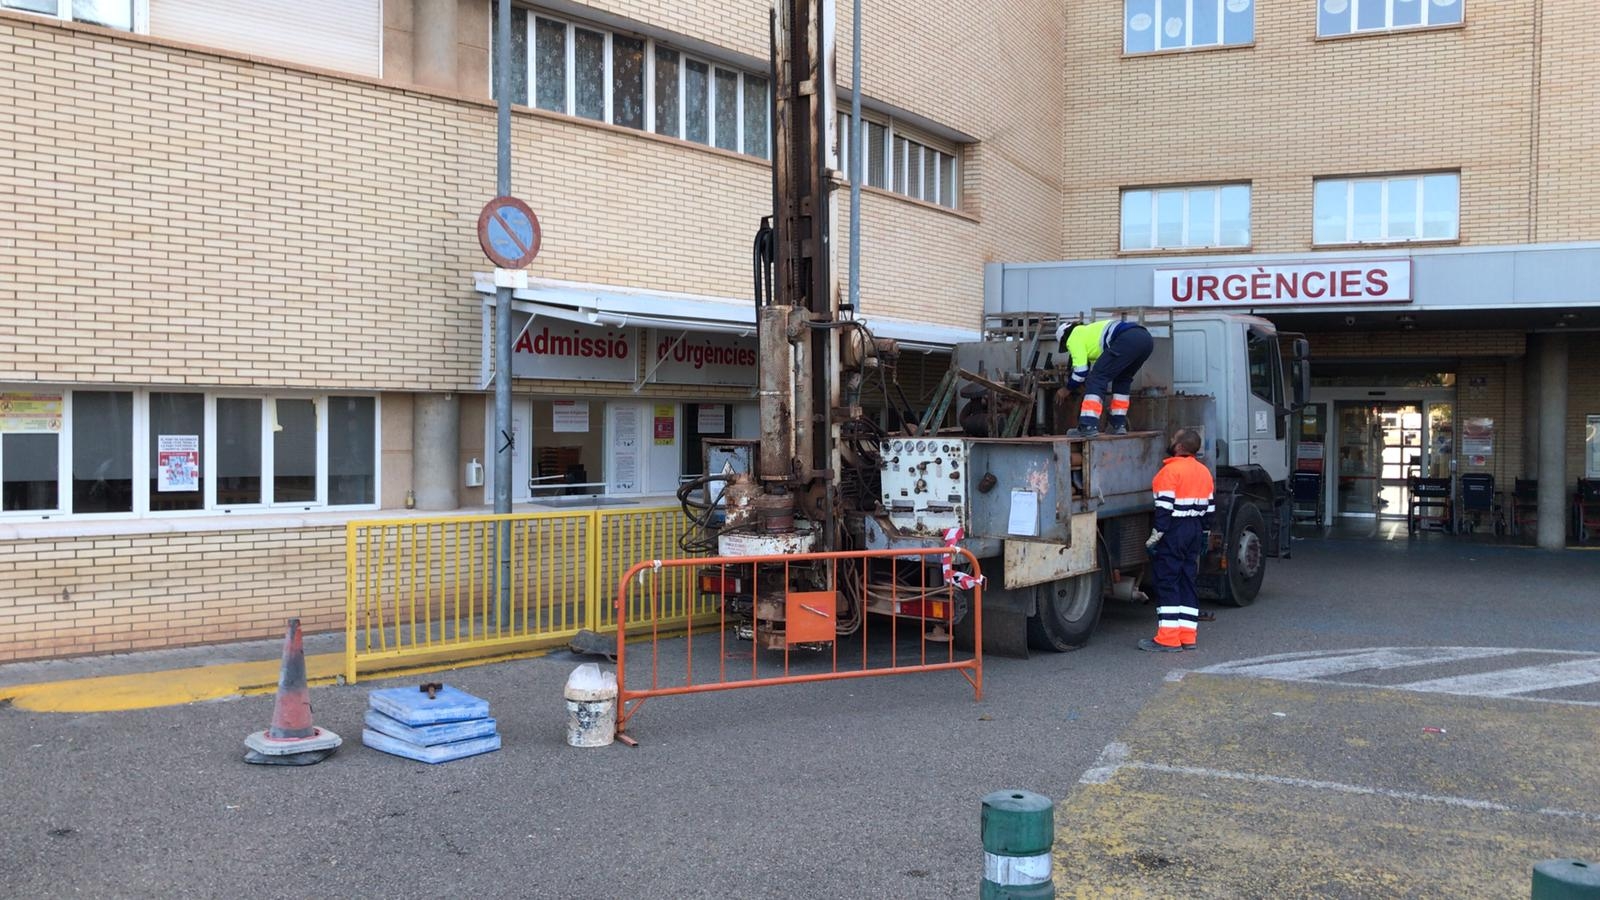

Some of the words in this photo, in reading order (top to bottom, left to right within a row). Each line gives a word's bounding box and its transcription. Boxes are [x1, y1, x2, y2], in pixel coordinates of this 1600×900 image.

[1171, 267, 1389, 301] URGÈNCIES
[515, 327, 629, 359] Admissió
[657, 336, 756, 369] d'Urgències
